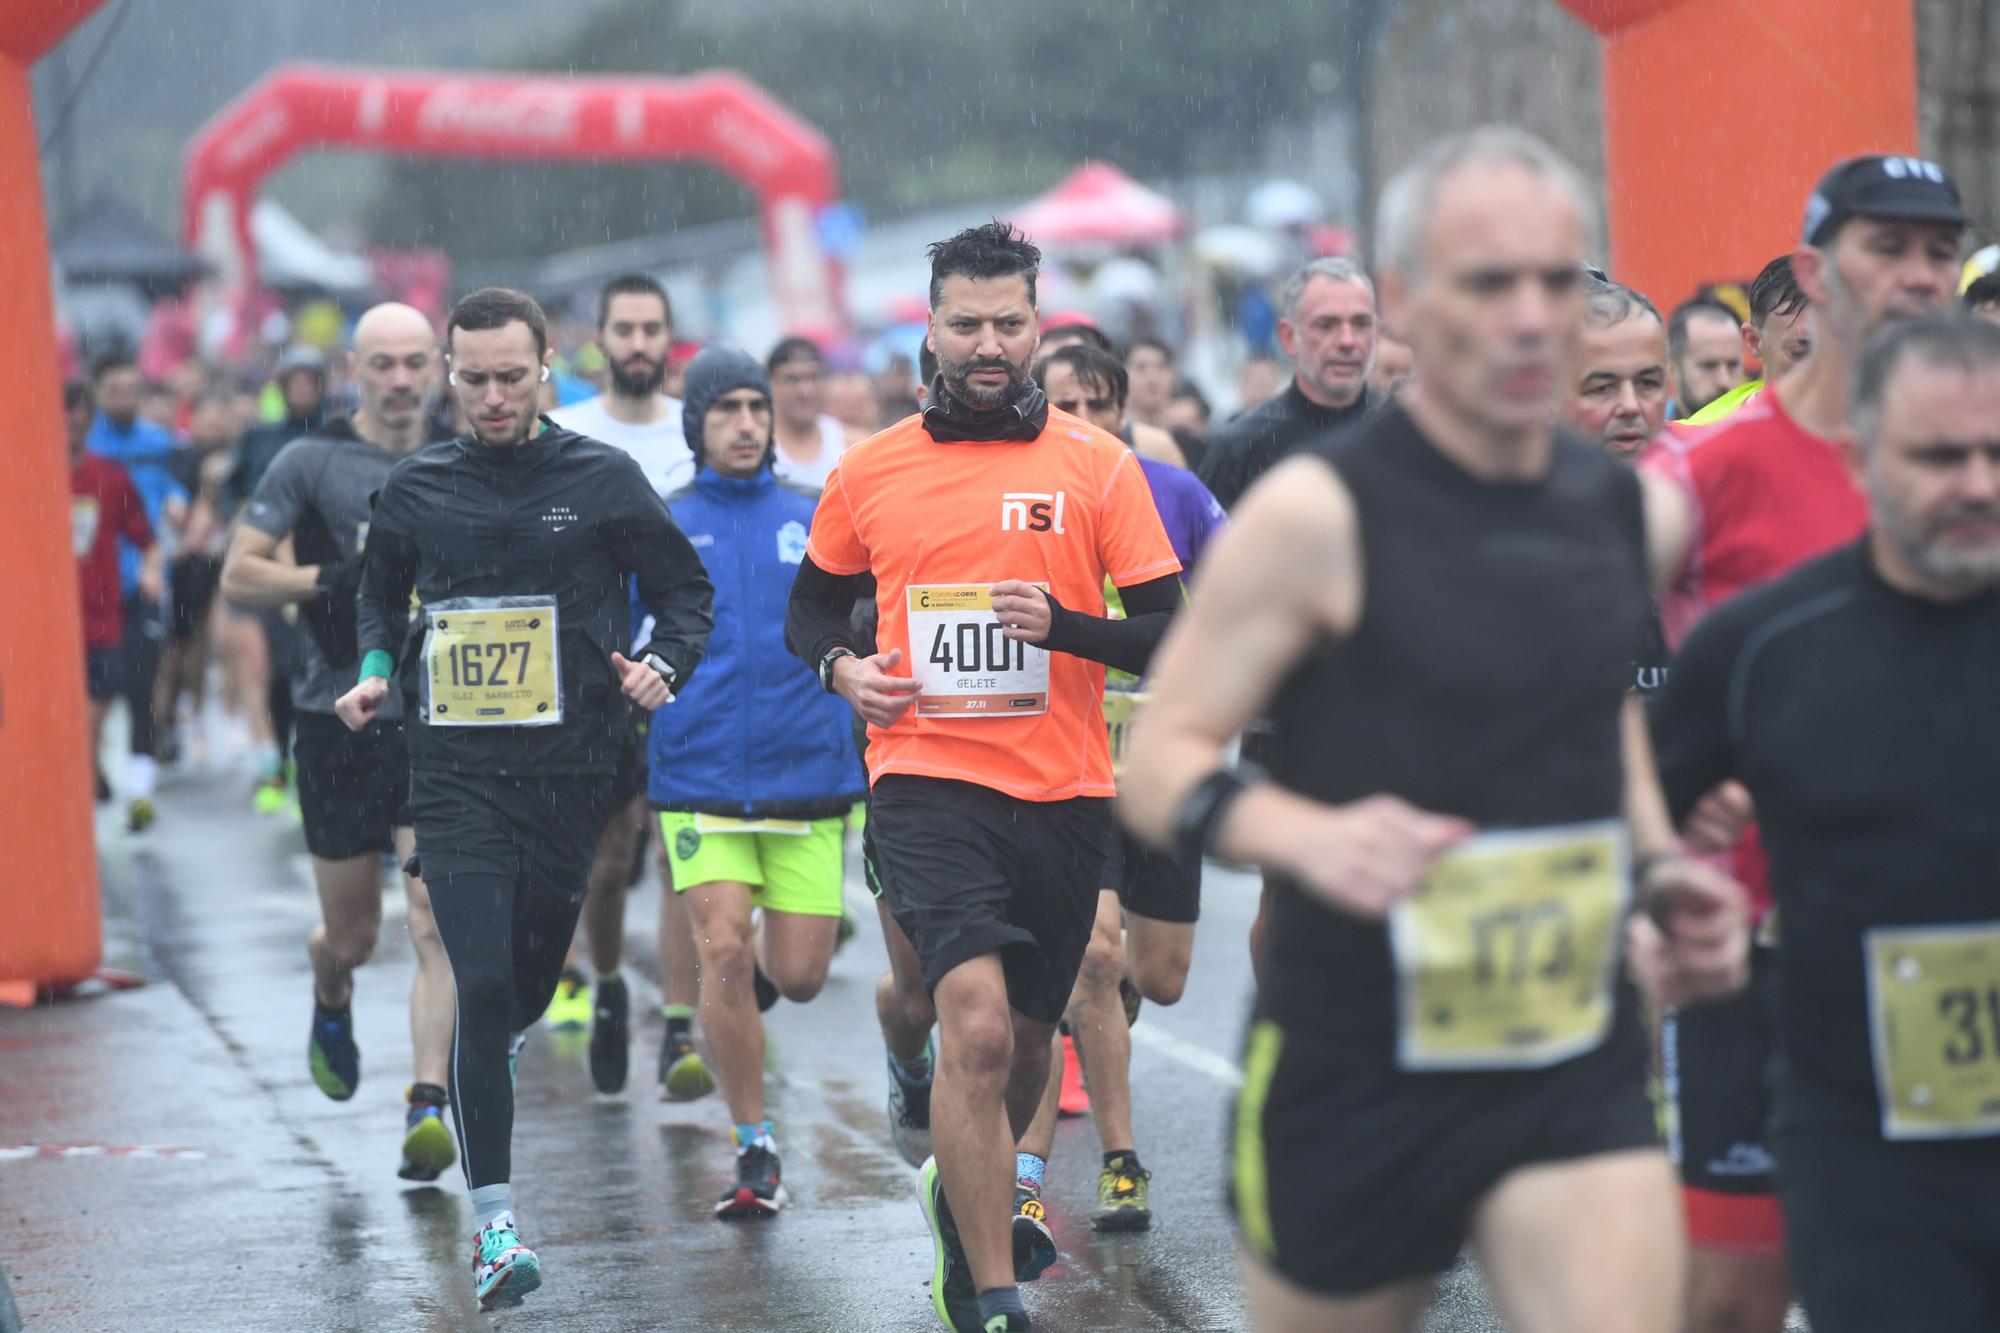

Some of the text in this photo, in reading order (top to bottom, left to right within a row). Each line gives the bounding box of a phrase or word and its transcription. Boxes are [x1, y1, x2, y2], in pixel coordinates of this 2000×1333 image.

[1001, 490, 1066, 535] nsl
[449, 641, 532, 687] 1627
[957, 678, 997, 690] GELETE
[966, 699, 987, 710] 27.11
